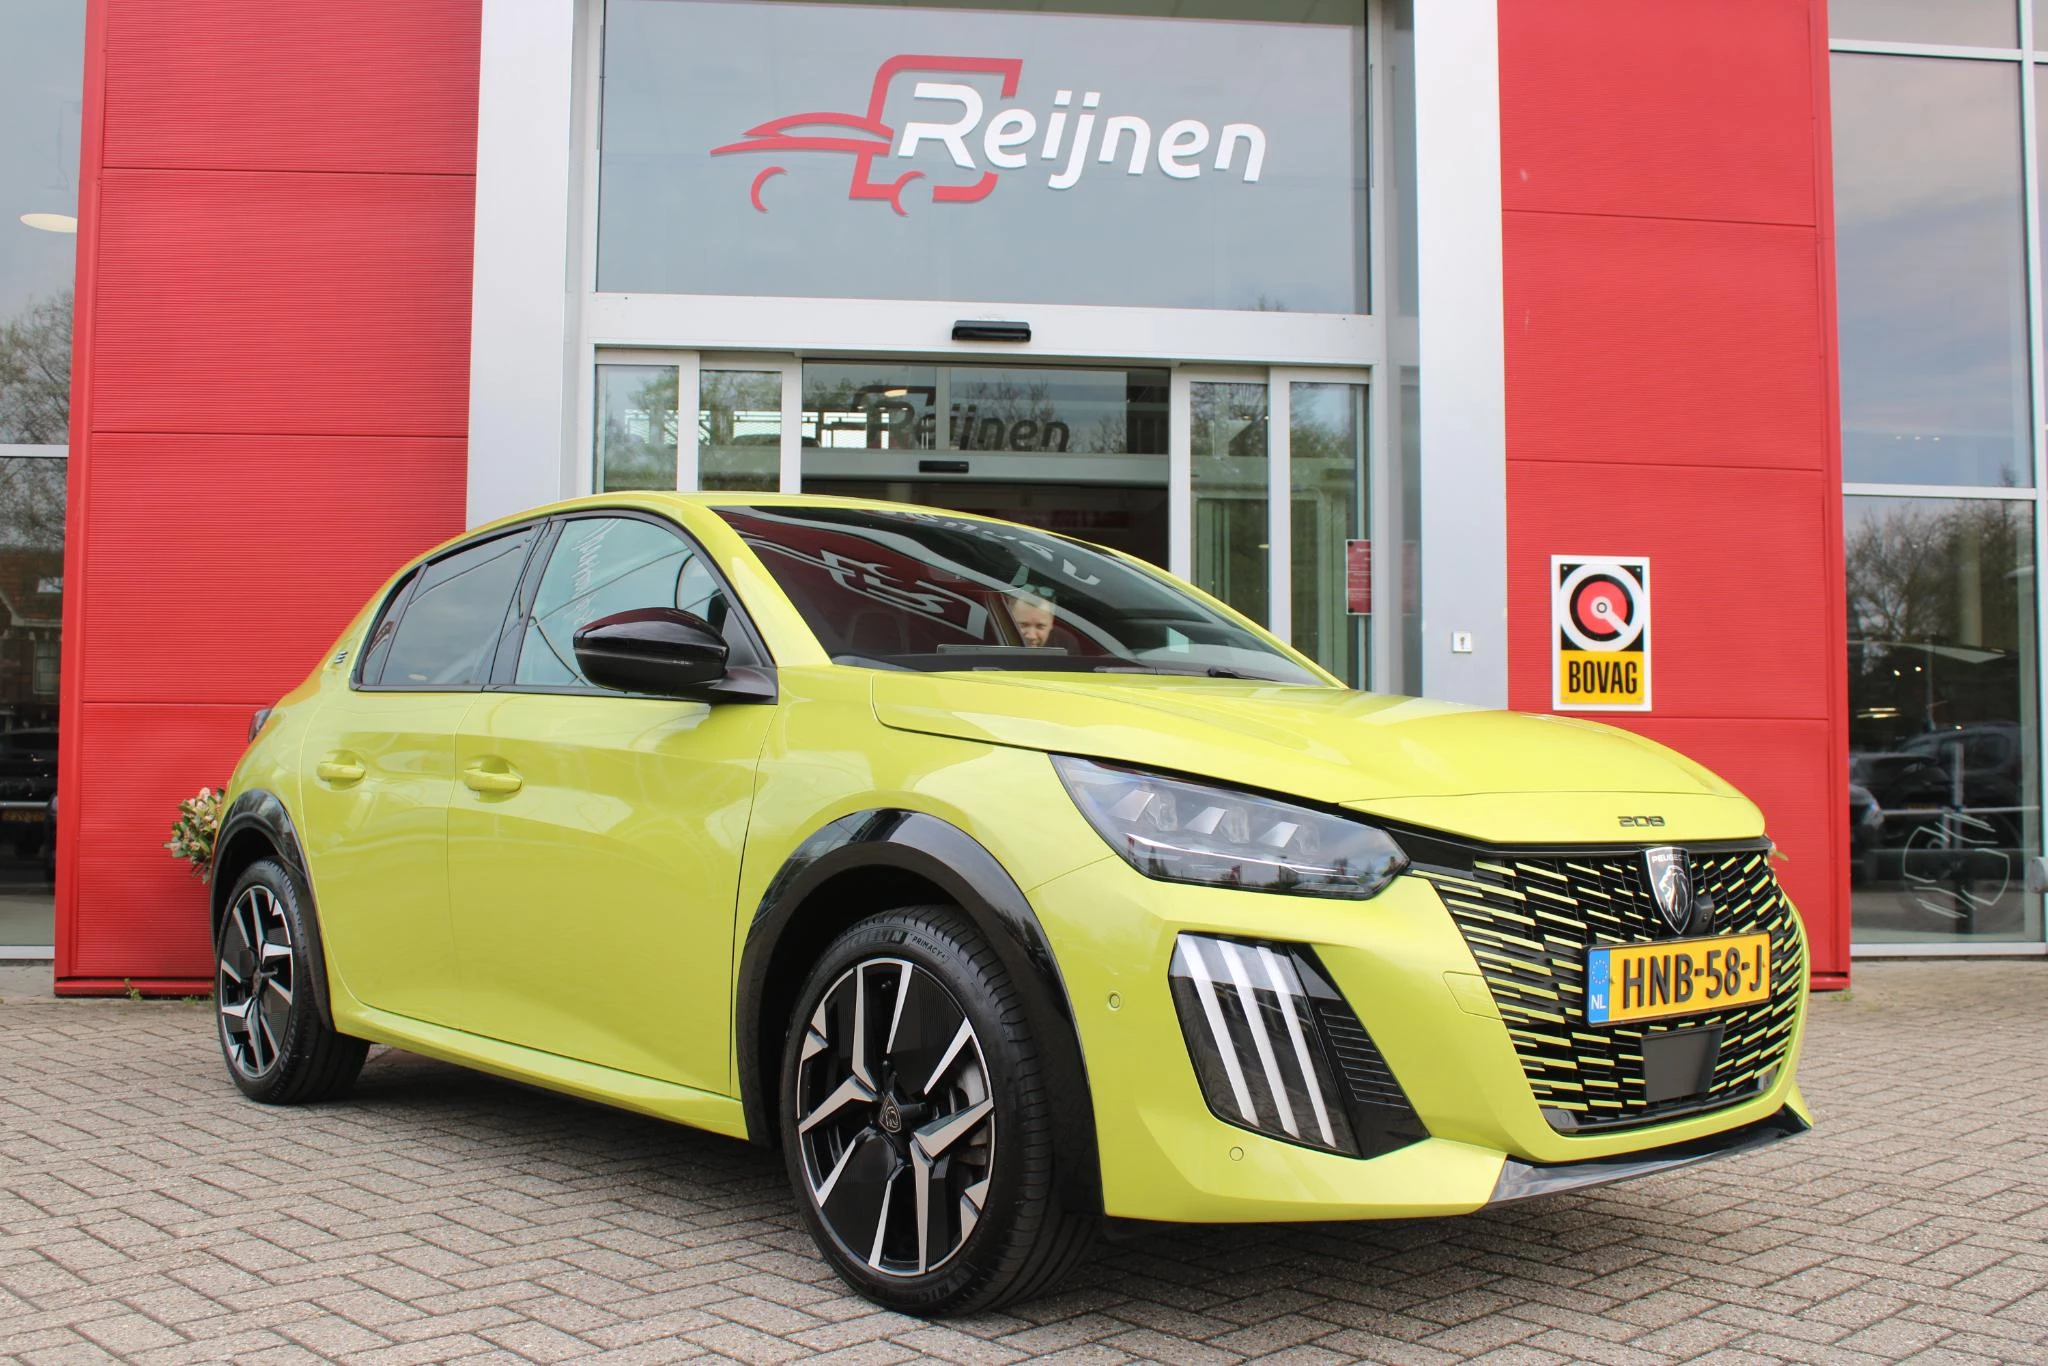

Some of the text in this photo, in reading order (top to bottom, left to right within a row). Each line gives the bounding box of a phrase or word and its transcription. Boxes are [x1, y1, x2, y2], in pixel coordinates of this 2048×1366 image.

[898, 82, 1267, 190] Reijnen
[1568, 660, 1638, 695] BOVAG
[1617, 815, 1665, 828] 208
[911, 935, 942, 956] PRIMACY
[1622, 943, 1764, 1011] HNB-58-J
[1591, 993, 1607, 1010] NL
